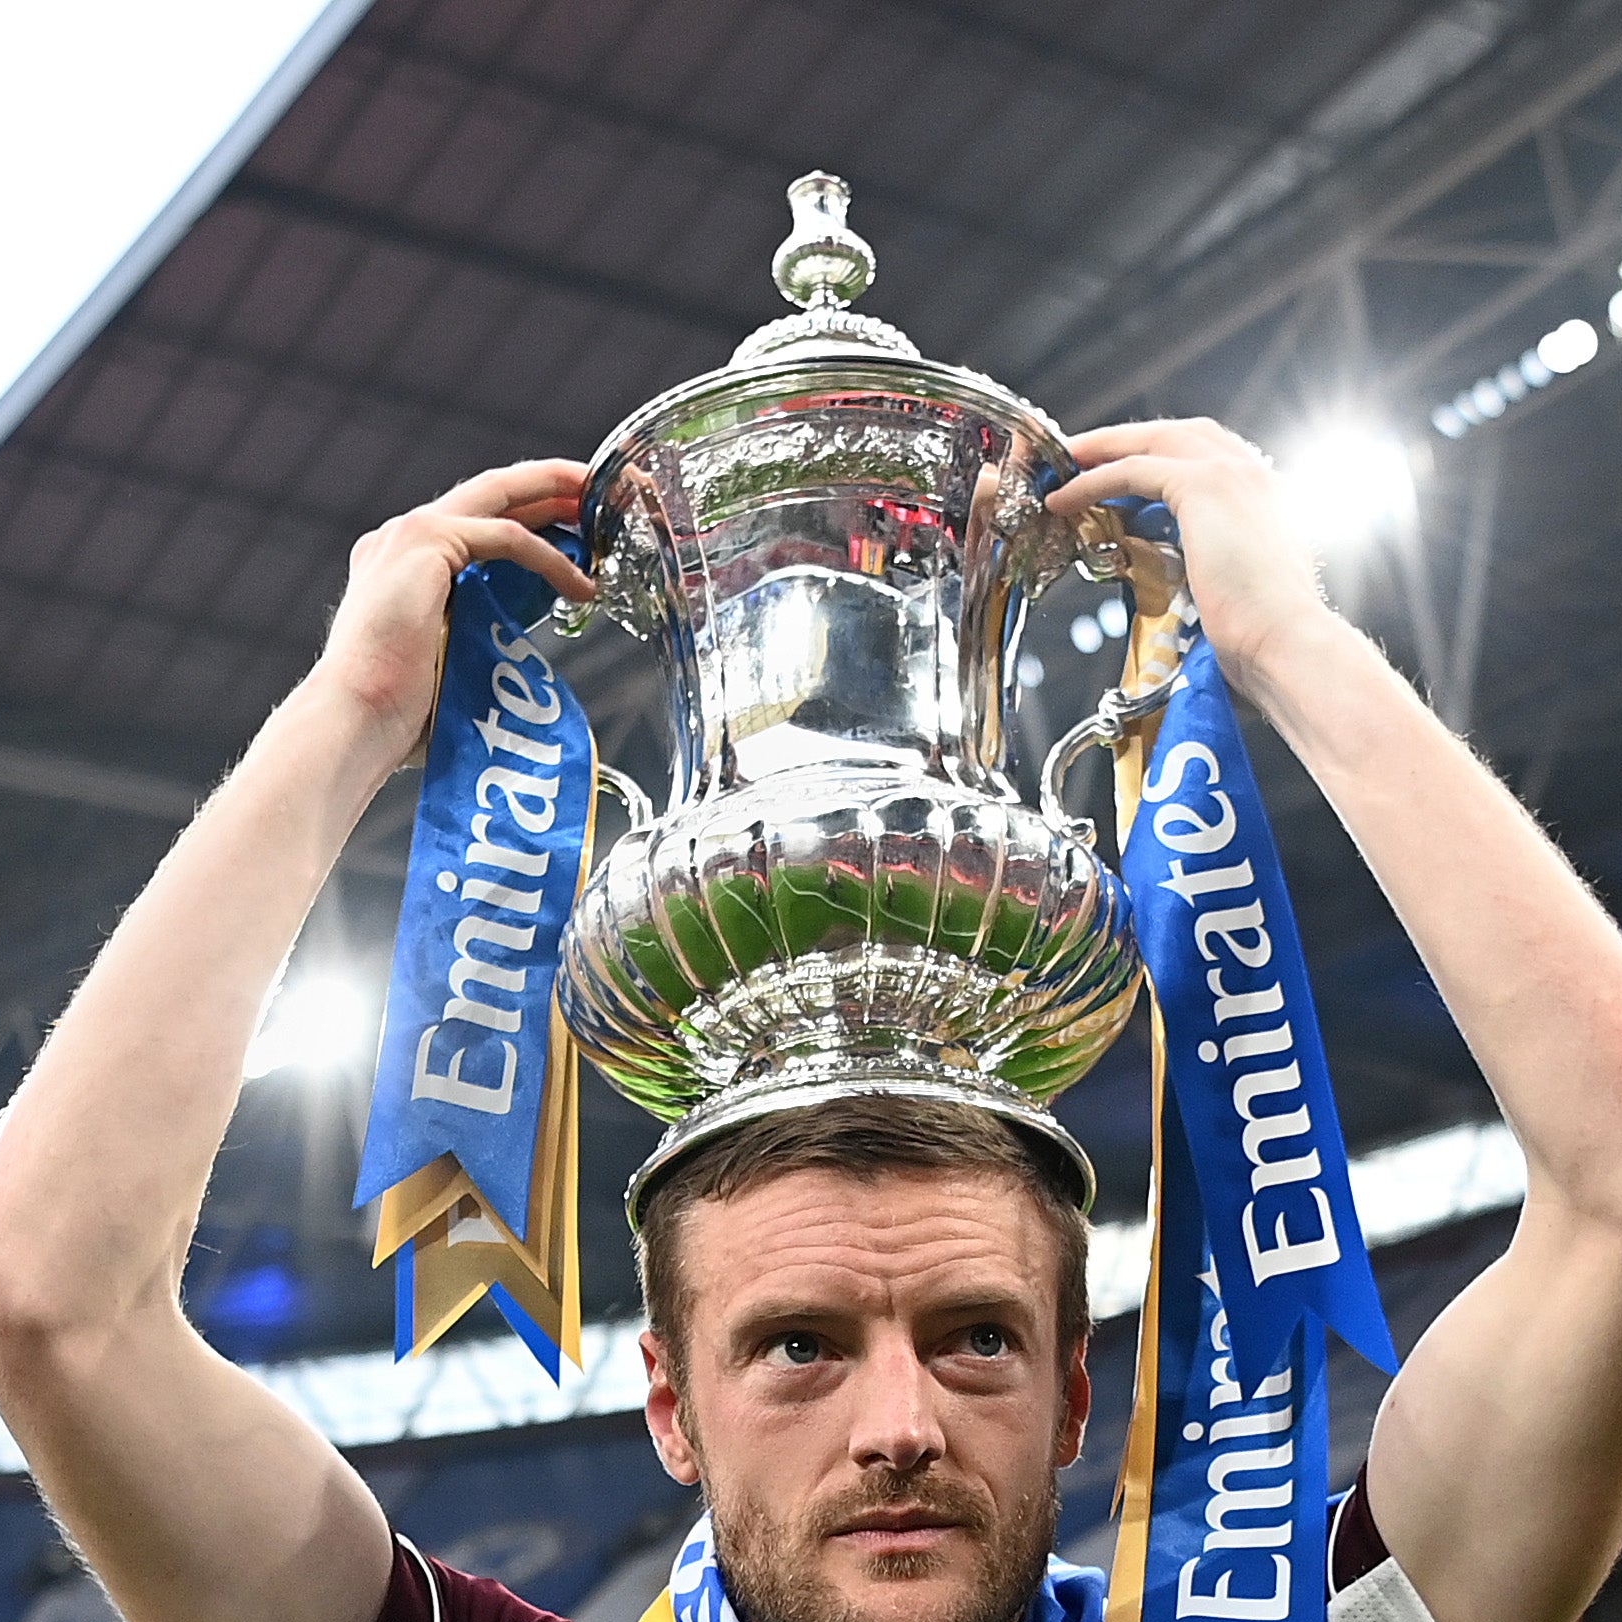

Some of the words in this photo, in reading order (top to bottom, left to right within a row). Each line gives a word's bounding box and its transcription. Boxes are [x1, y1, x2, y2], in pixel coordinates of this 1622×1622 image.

[411, 621, 563, 1116] Emirates
[1142, 740, 1340, 1288] Emirates
[1176, 1254, 1293, 1621] Emir
